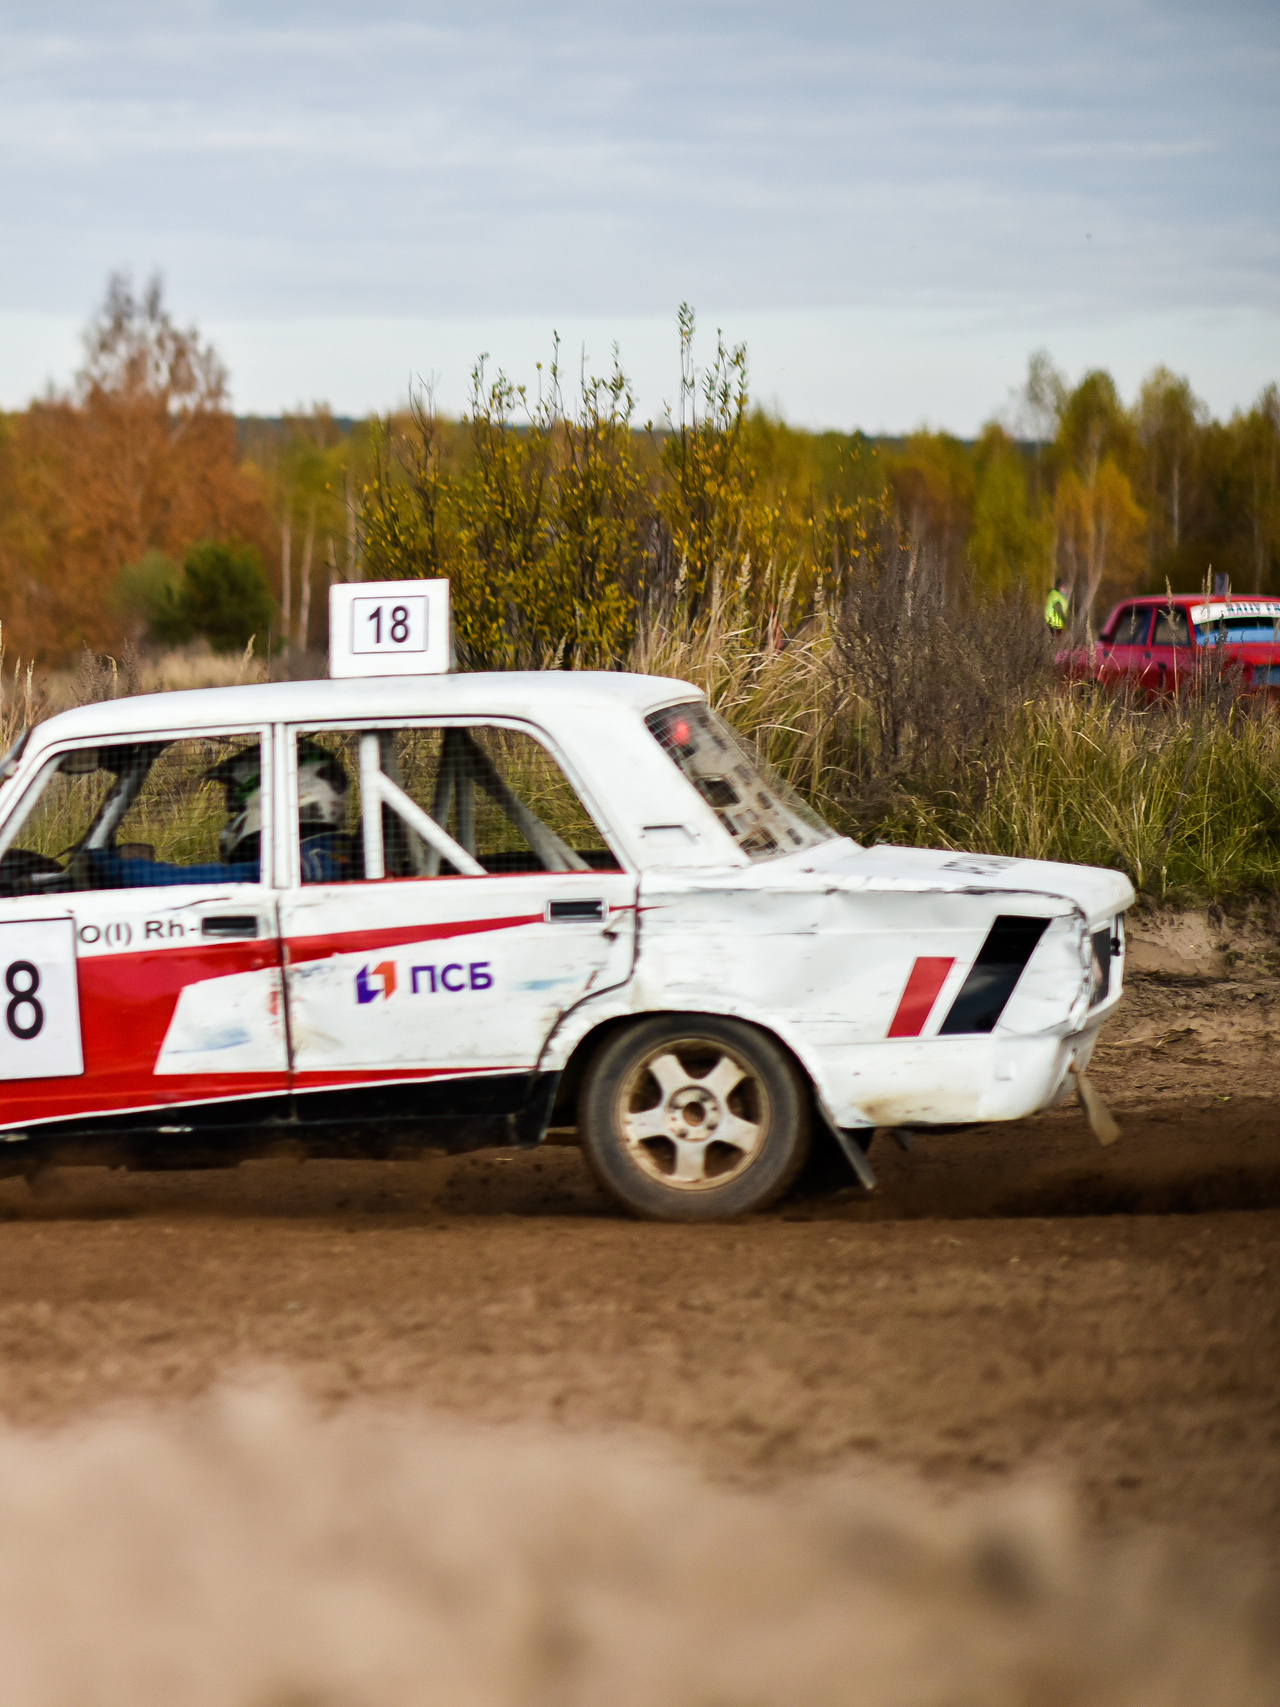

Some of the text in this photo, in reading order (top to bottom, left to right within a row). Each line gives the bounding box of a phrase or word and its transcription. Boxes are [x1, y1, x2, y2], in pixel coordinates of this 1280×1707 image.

[367, 605, 410, 644] 18
[144, 918, 200, 940] Rh-
[410, 961, 495, 994] ПСБ
